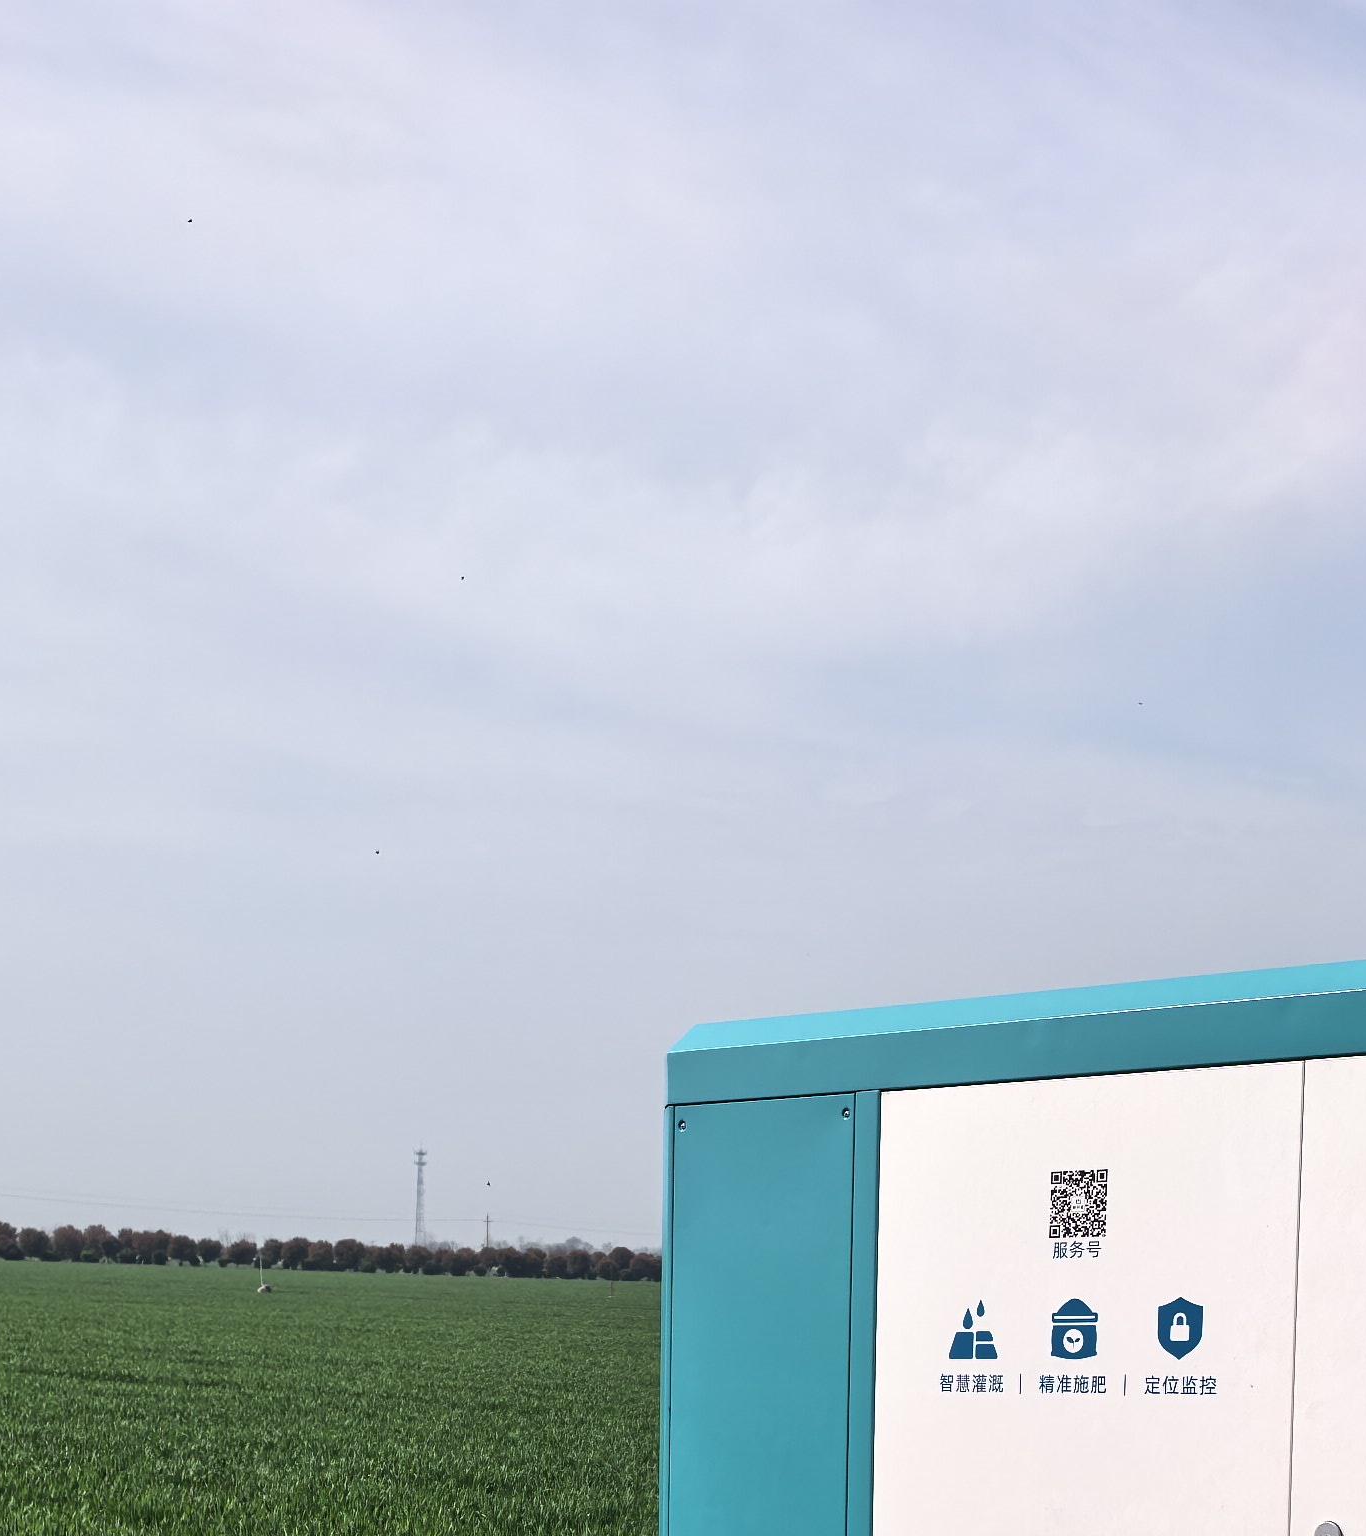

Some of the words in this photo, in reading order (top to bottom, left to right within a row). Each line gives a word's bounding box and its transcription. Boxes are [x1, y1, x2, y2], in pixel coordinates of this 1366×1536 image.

[1052, 1240, 1102, 1259] 服务号
[939, 1373, 1004, 1394] 智慧灌溉
[1038, 1374, 1107, 1395] 精准施肥
[1143, 1375, 1218, 1396] 定位监控
